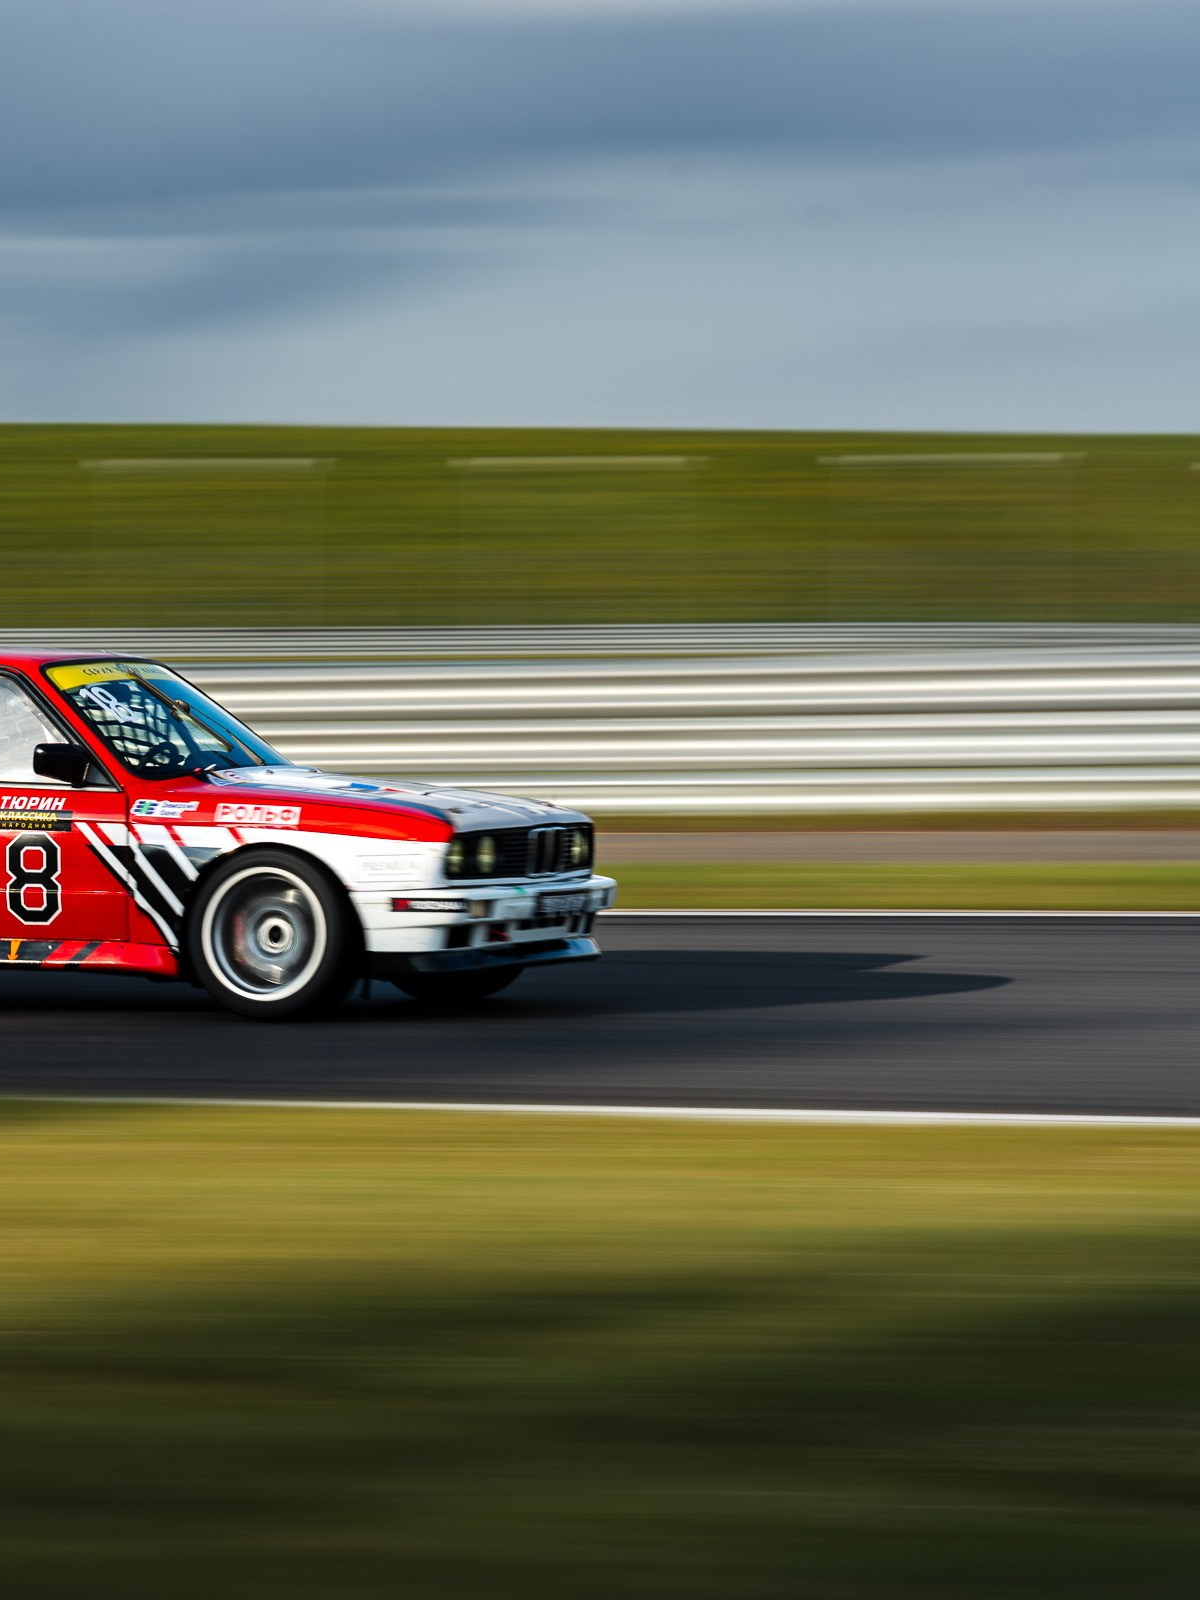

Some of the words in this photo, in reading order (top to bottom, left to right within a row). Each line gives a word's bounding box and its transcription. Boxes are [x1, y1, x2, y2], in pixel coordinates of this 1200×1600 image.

[79, 686, 138, 724] 18
[0, 796, 66, 810] ТЮРИН
[0, 811, 57, 822] КЛАССИКА
[220, 804, 296, 821] РОЛЬФ
